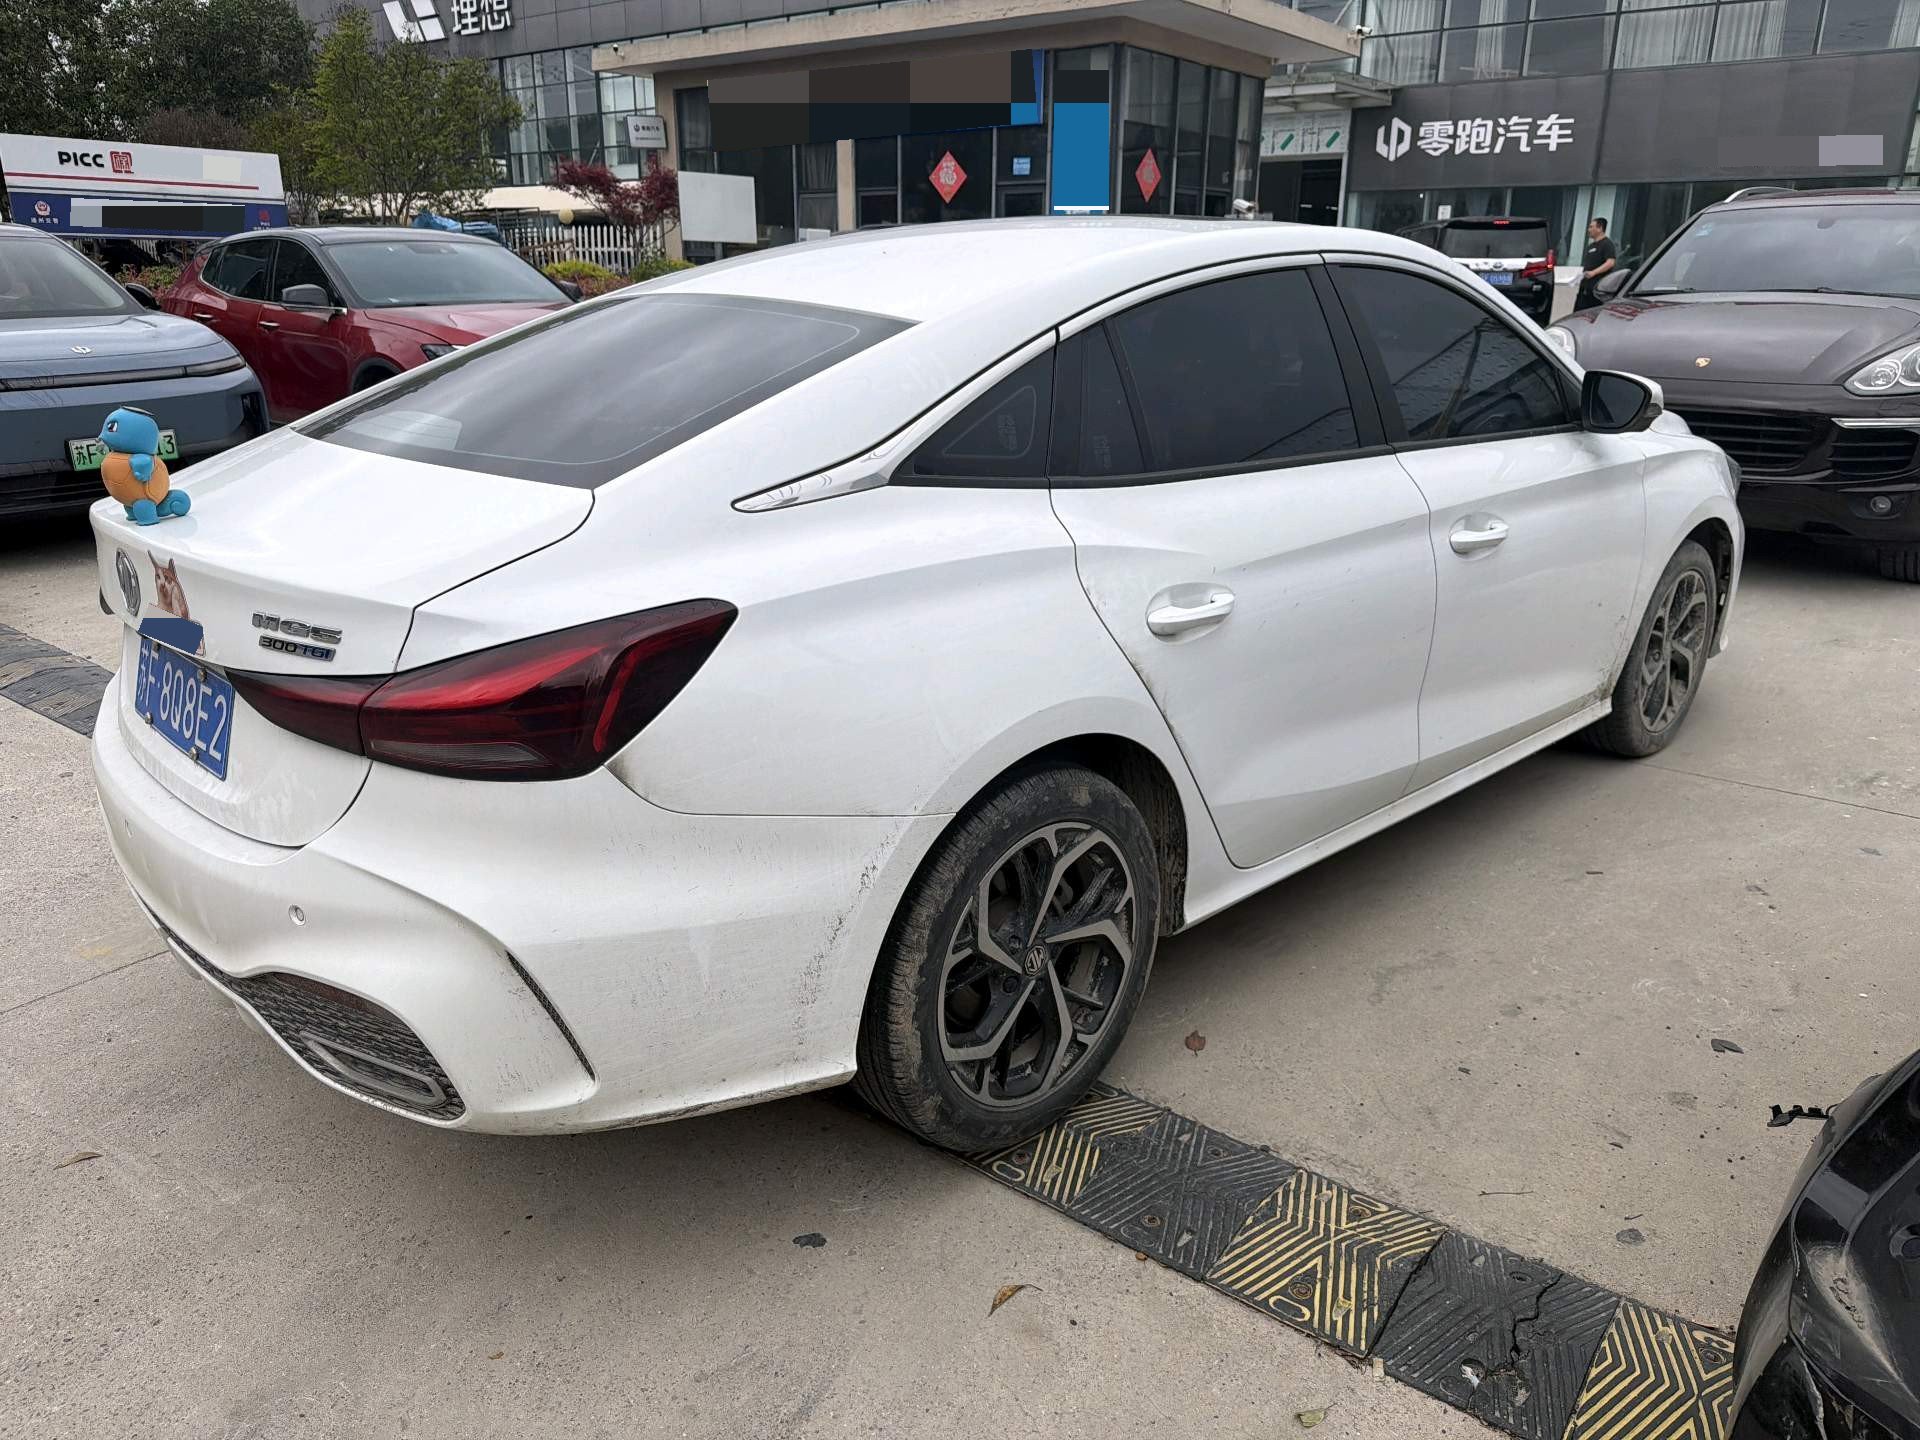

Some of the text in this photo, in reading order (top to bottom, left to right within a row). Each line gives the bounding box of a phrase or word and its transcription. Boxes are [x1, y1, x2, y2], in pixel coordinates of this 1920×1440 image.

[451, 0, 511, 35] 理想
[1417, 113, 1575, 156] 零跑汽车
[57, 151, 105, 168] PICC
